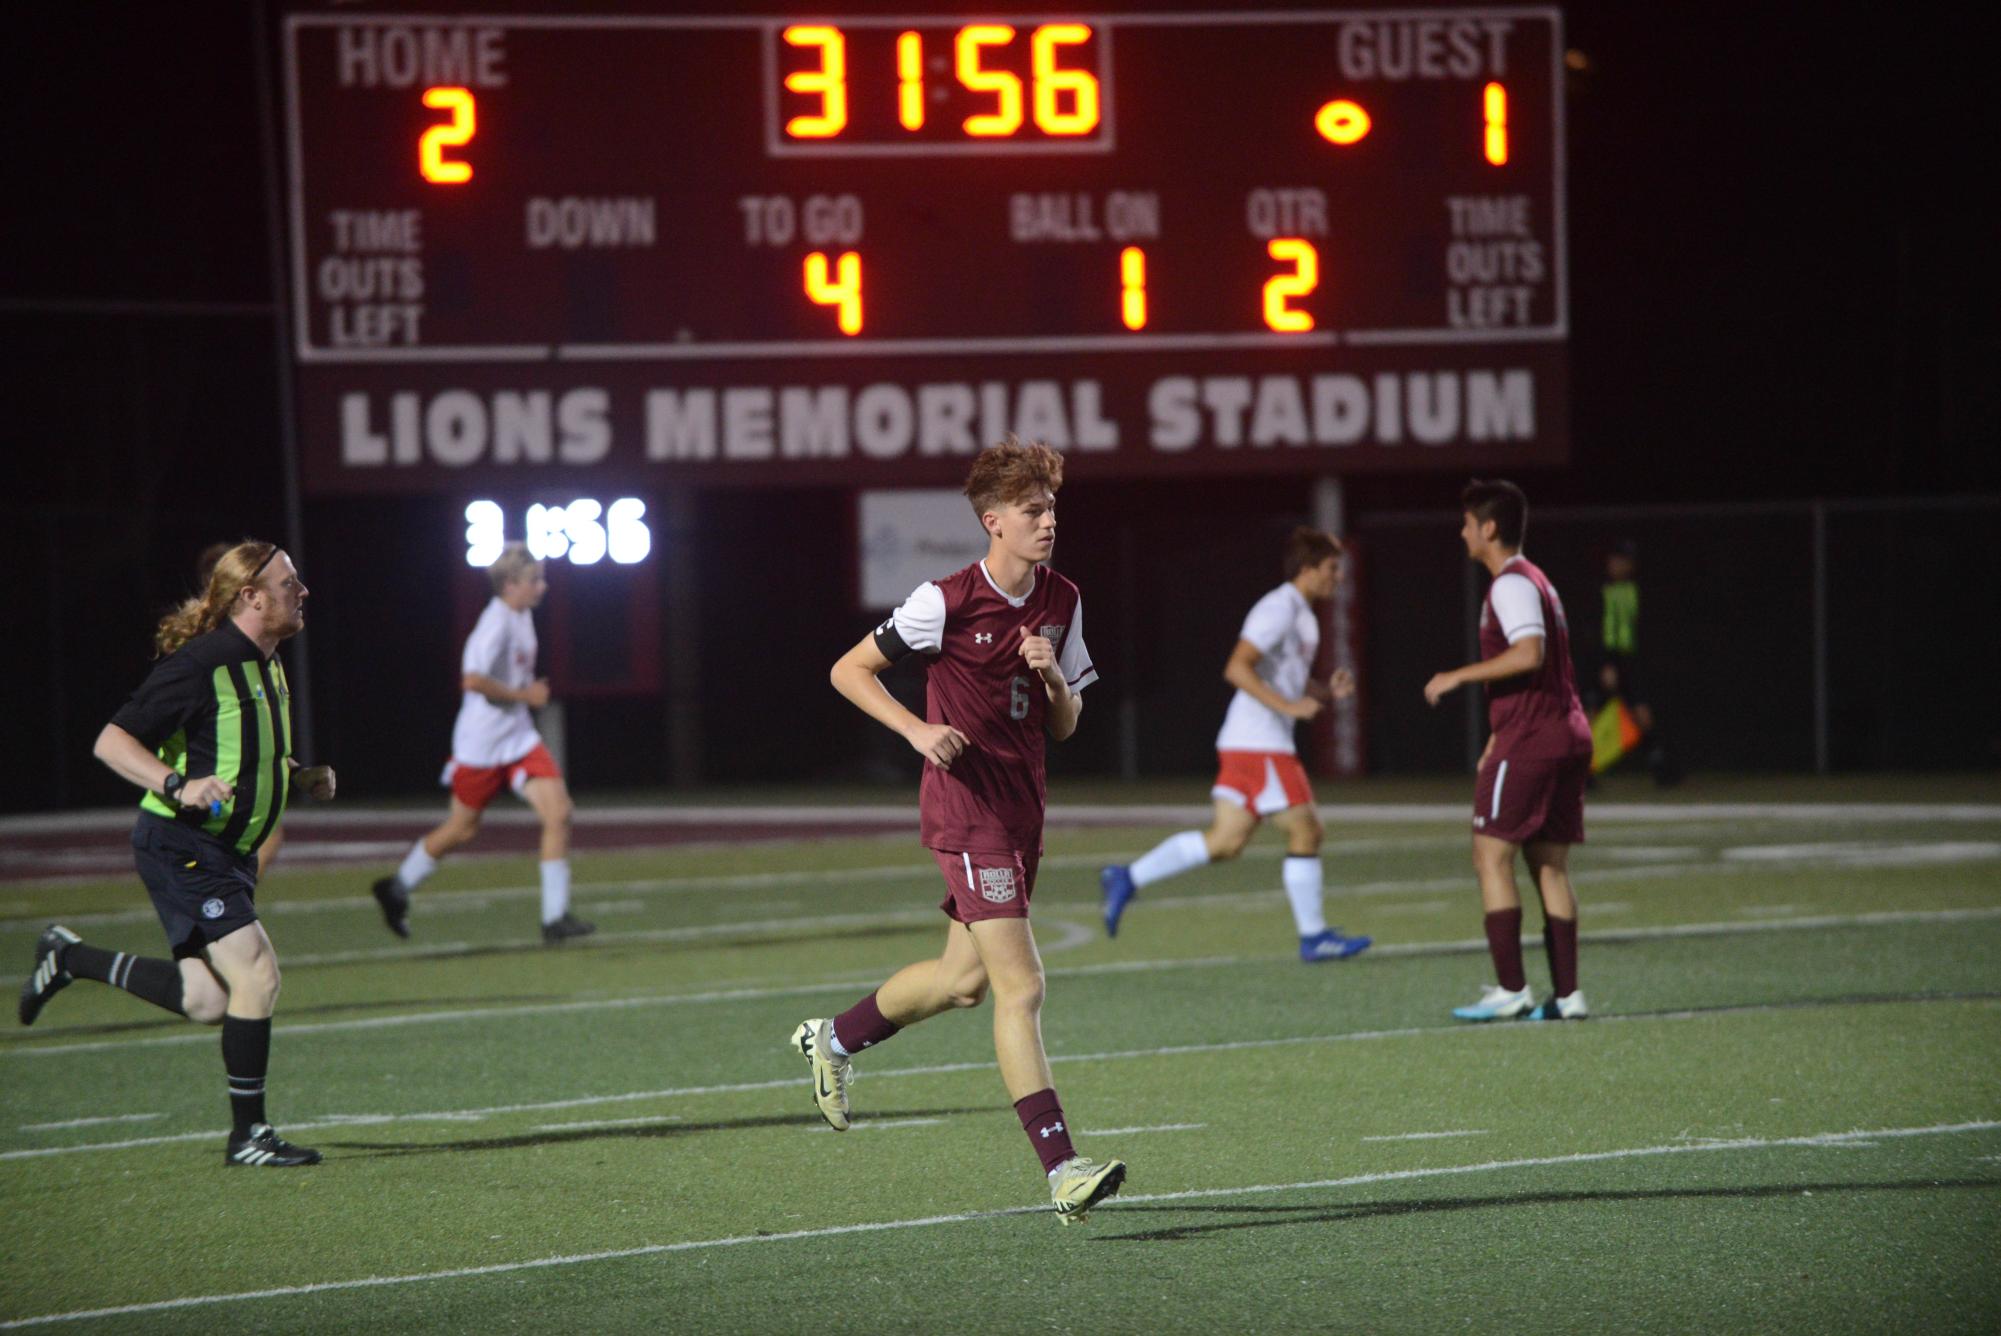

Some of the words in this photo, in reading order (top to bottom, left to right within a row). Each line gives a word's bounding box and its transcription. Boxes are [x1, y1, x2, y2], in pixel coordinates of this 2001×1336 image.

[338, 27, 509, 88] HOME
[1338, 22, 1514, 81] GUEST
[418, 86, 477, 184] 2
[1482, 81, 1509, 166] 1
[330, 209, 423, 254] TIME
[525, 198, 656, 248] DOWN
[739, 195, 793, 246] TO
[802, 194, 864, 246] GO
[1010, 192, 1099, 242] BALL
[1105, 190, 1160, 241] ON
[1245, 188, 1329, 239] QTR
[1446, 195, 1533, 239] TIME
[318, 257, 425, 301] OUTS
[1120, 245, 1148, 331] 1
[1261, 237, 1319, 333] 2
[1446, 240, 1545, 285] OUTS
[803, 250, 864, 336] 4
[1447, 287, 1533, 330] LEFT
[330, 304, 424, 347] LEFT
[340, 387, 613, 468] LIONS
[644, 379, 1119, 461] MEMORIAL
[1148, 369, 1536, 454] STADIUM
[1010, 675, 1030, 720] 6
